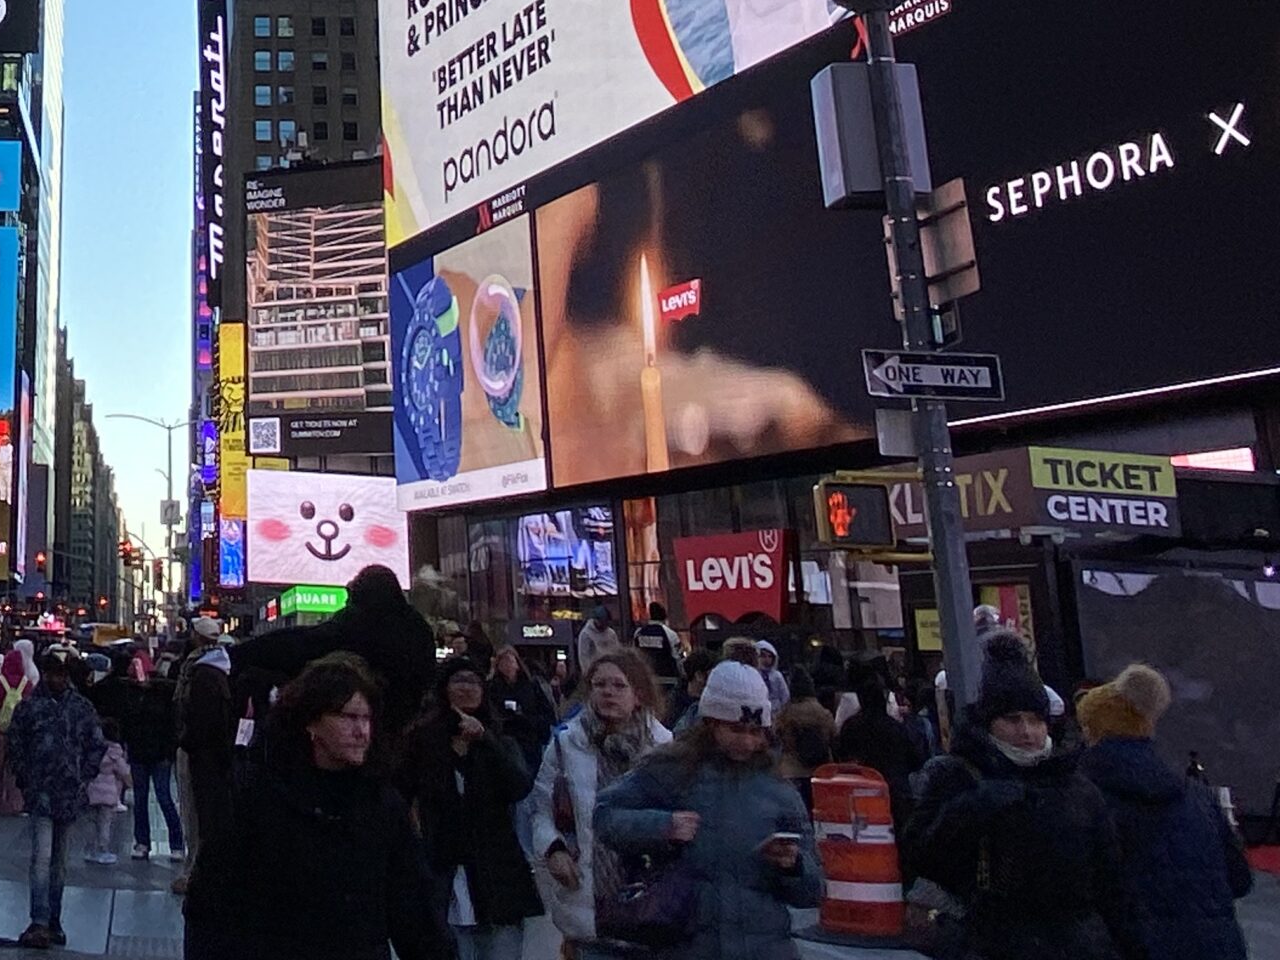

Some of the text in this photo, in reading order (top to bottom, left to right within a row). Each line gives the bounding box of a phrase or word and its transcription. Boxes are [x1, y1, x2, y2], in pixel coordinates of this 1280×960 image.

[407, 24, 420, 57] &
[436, 29, 555, 130] THAN NEVER'
[442, 98, 556, 203] pandora
[986, 103, 1250, 222] SEPHORA X
[246, 188, 282, 200] IMAGINE
[246, 198, 286, 210] WONDER
[492, 185, 526, 209] MARRIOTT
[492, 200, 523, 223] MARQUIS
[885, 365, 981, 385] ONE WAY
[1043, 458, 1162, 492] TICKET
[954, 468, 1013, 518] TIX
[1047, 495, 1169, 527] CENTER
